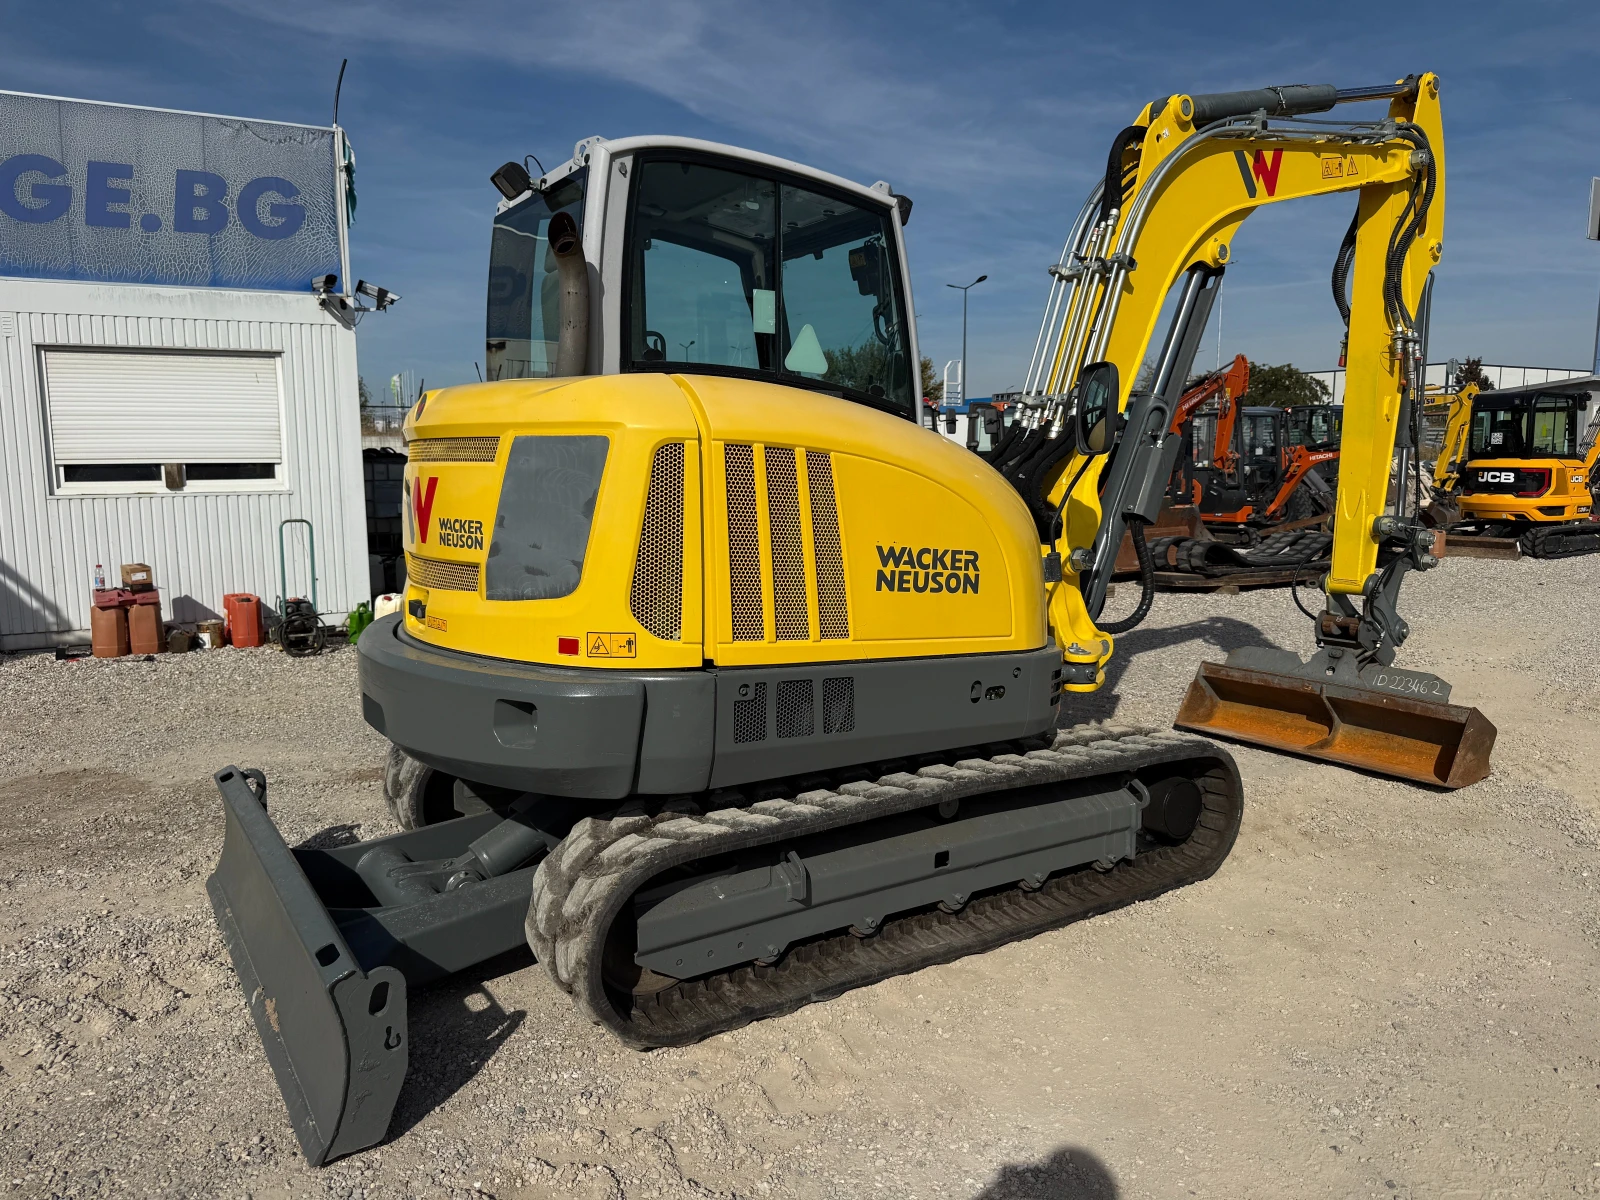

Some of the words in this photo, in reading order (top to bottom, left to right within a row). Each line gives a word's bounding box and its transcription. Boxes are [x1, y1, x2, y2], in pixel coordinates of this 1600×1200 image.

[0, 153, 306, 240] GE.BG
[1309, 452, 1333, 461] HITACHI
[1478, 471, 1515, 482] JCB
[439, 517, 483, 535] WACKER
[439, 532, 483, 550] NEUSON
[876, 545, 980, 572] WACKER
[876, 569, 980, 594] NEUSON
[1389, 675, 1443, 696] 223462
